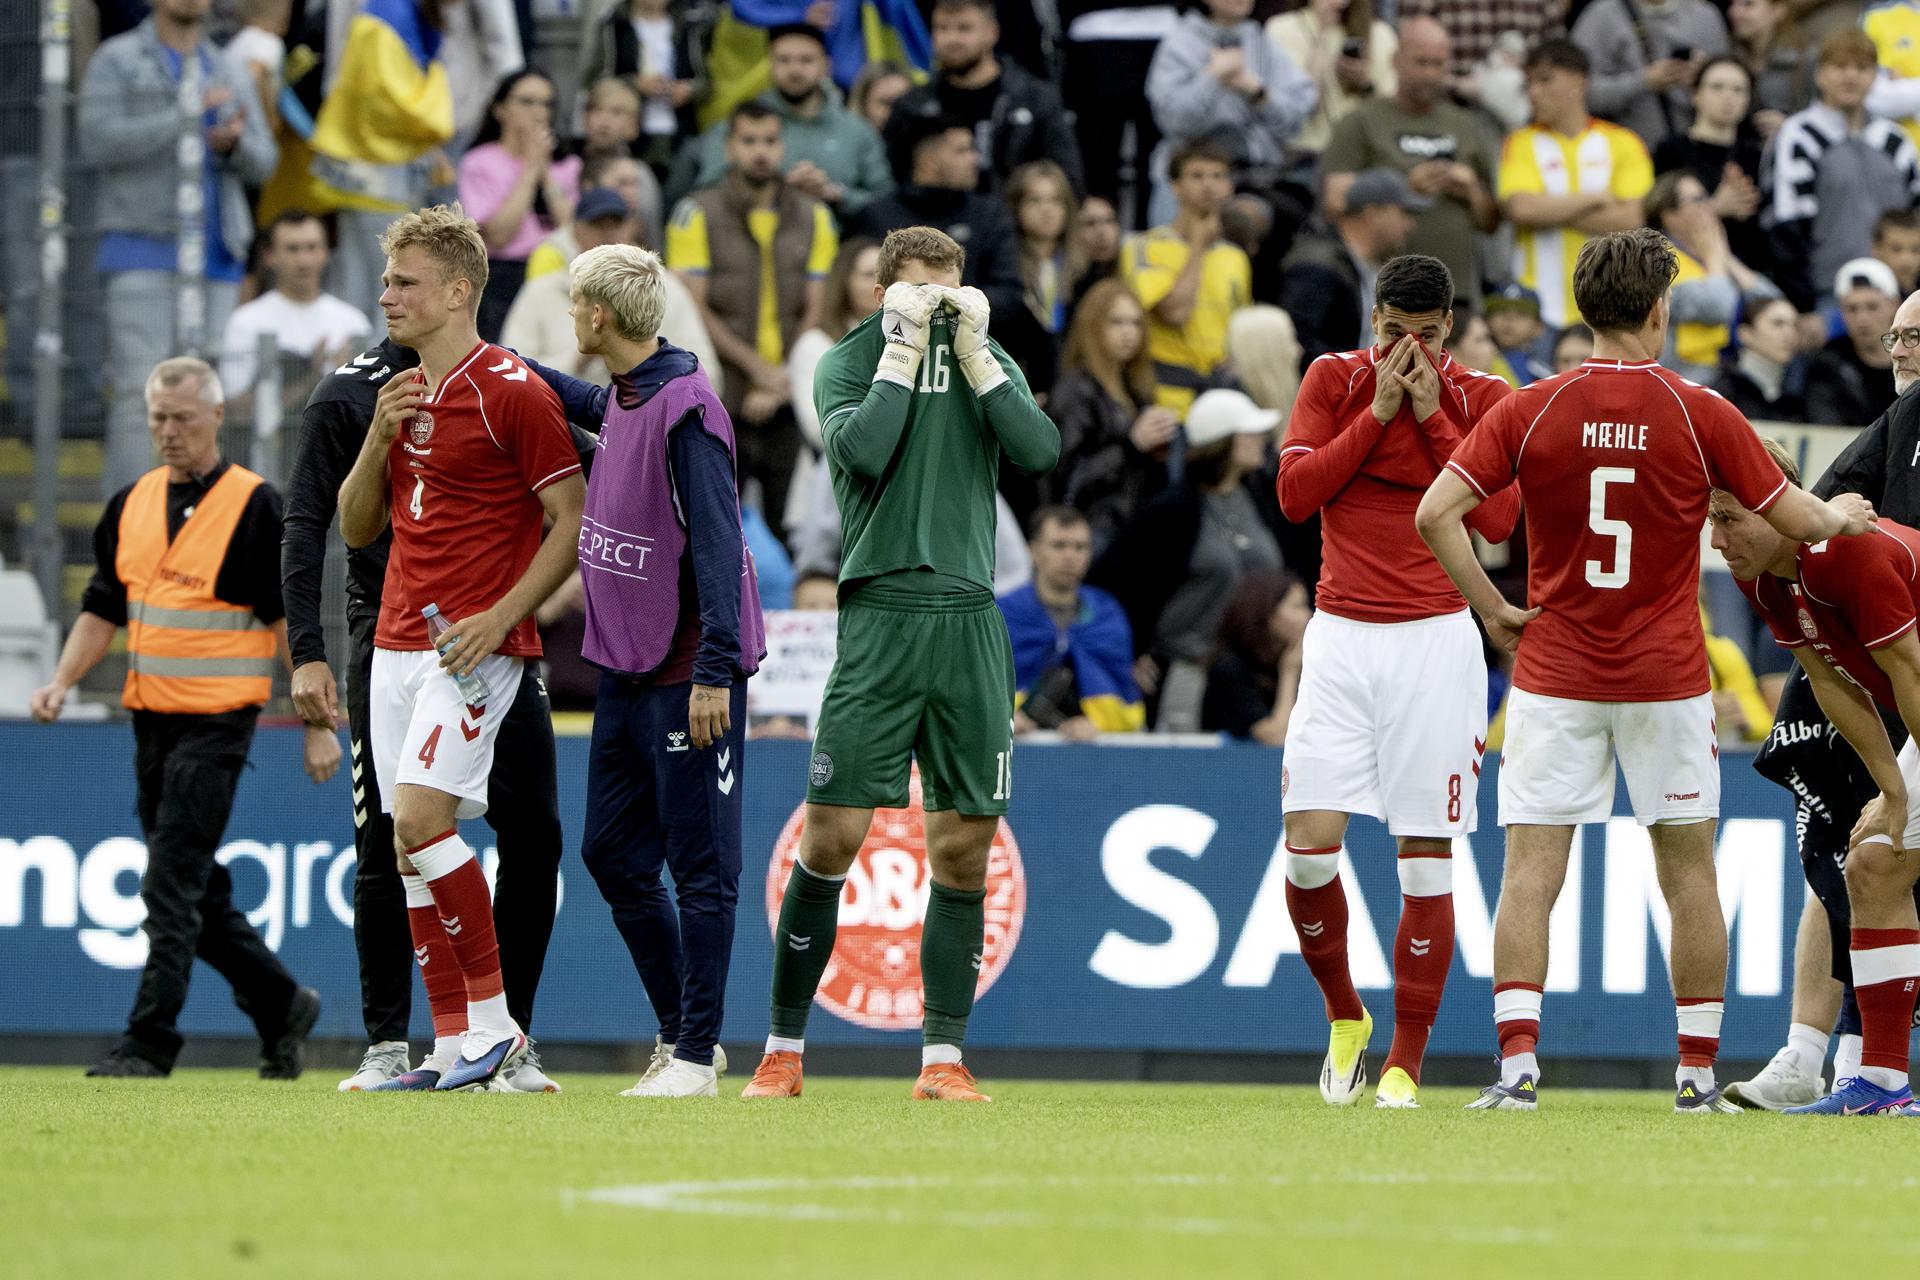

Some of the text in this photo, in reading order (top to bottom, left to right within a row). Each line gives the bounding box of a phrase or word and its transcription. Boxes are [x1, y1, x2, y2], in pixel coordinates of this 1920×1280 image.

[920, 344, 950, 393] 16
[1582, 422, 1648, 451] MÆHLE
[410, 474, 424, 520] 4
[1585, 466, 1636, 589] 5
[418, 724, 442, 769] 4
[1448, 774, 1461, 822] 8
